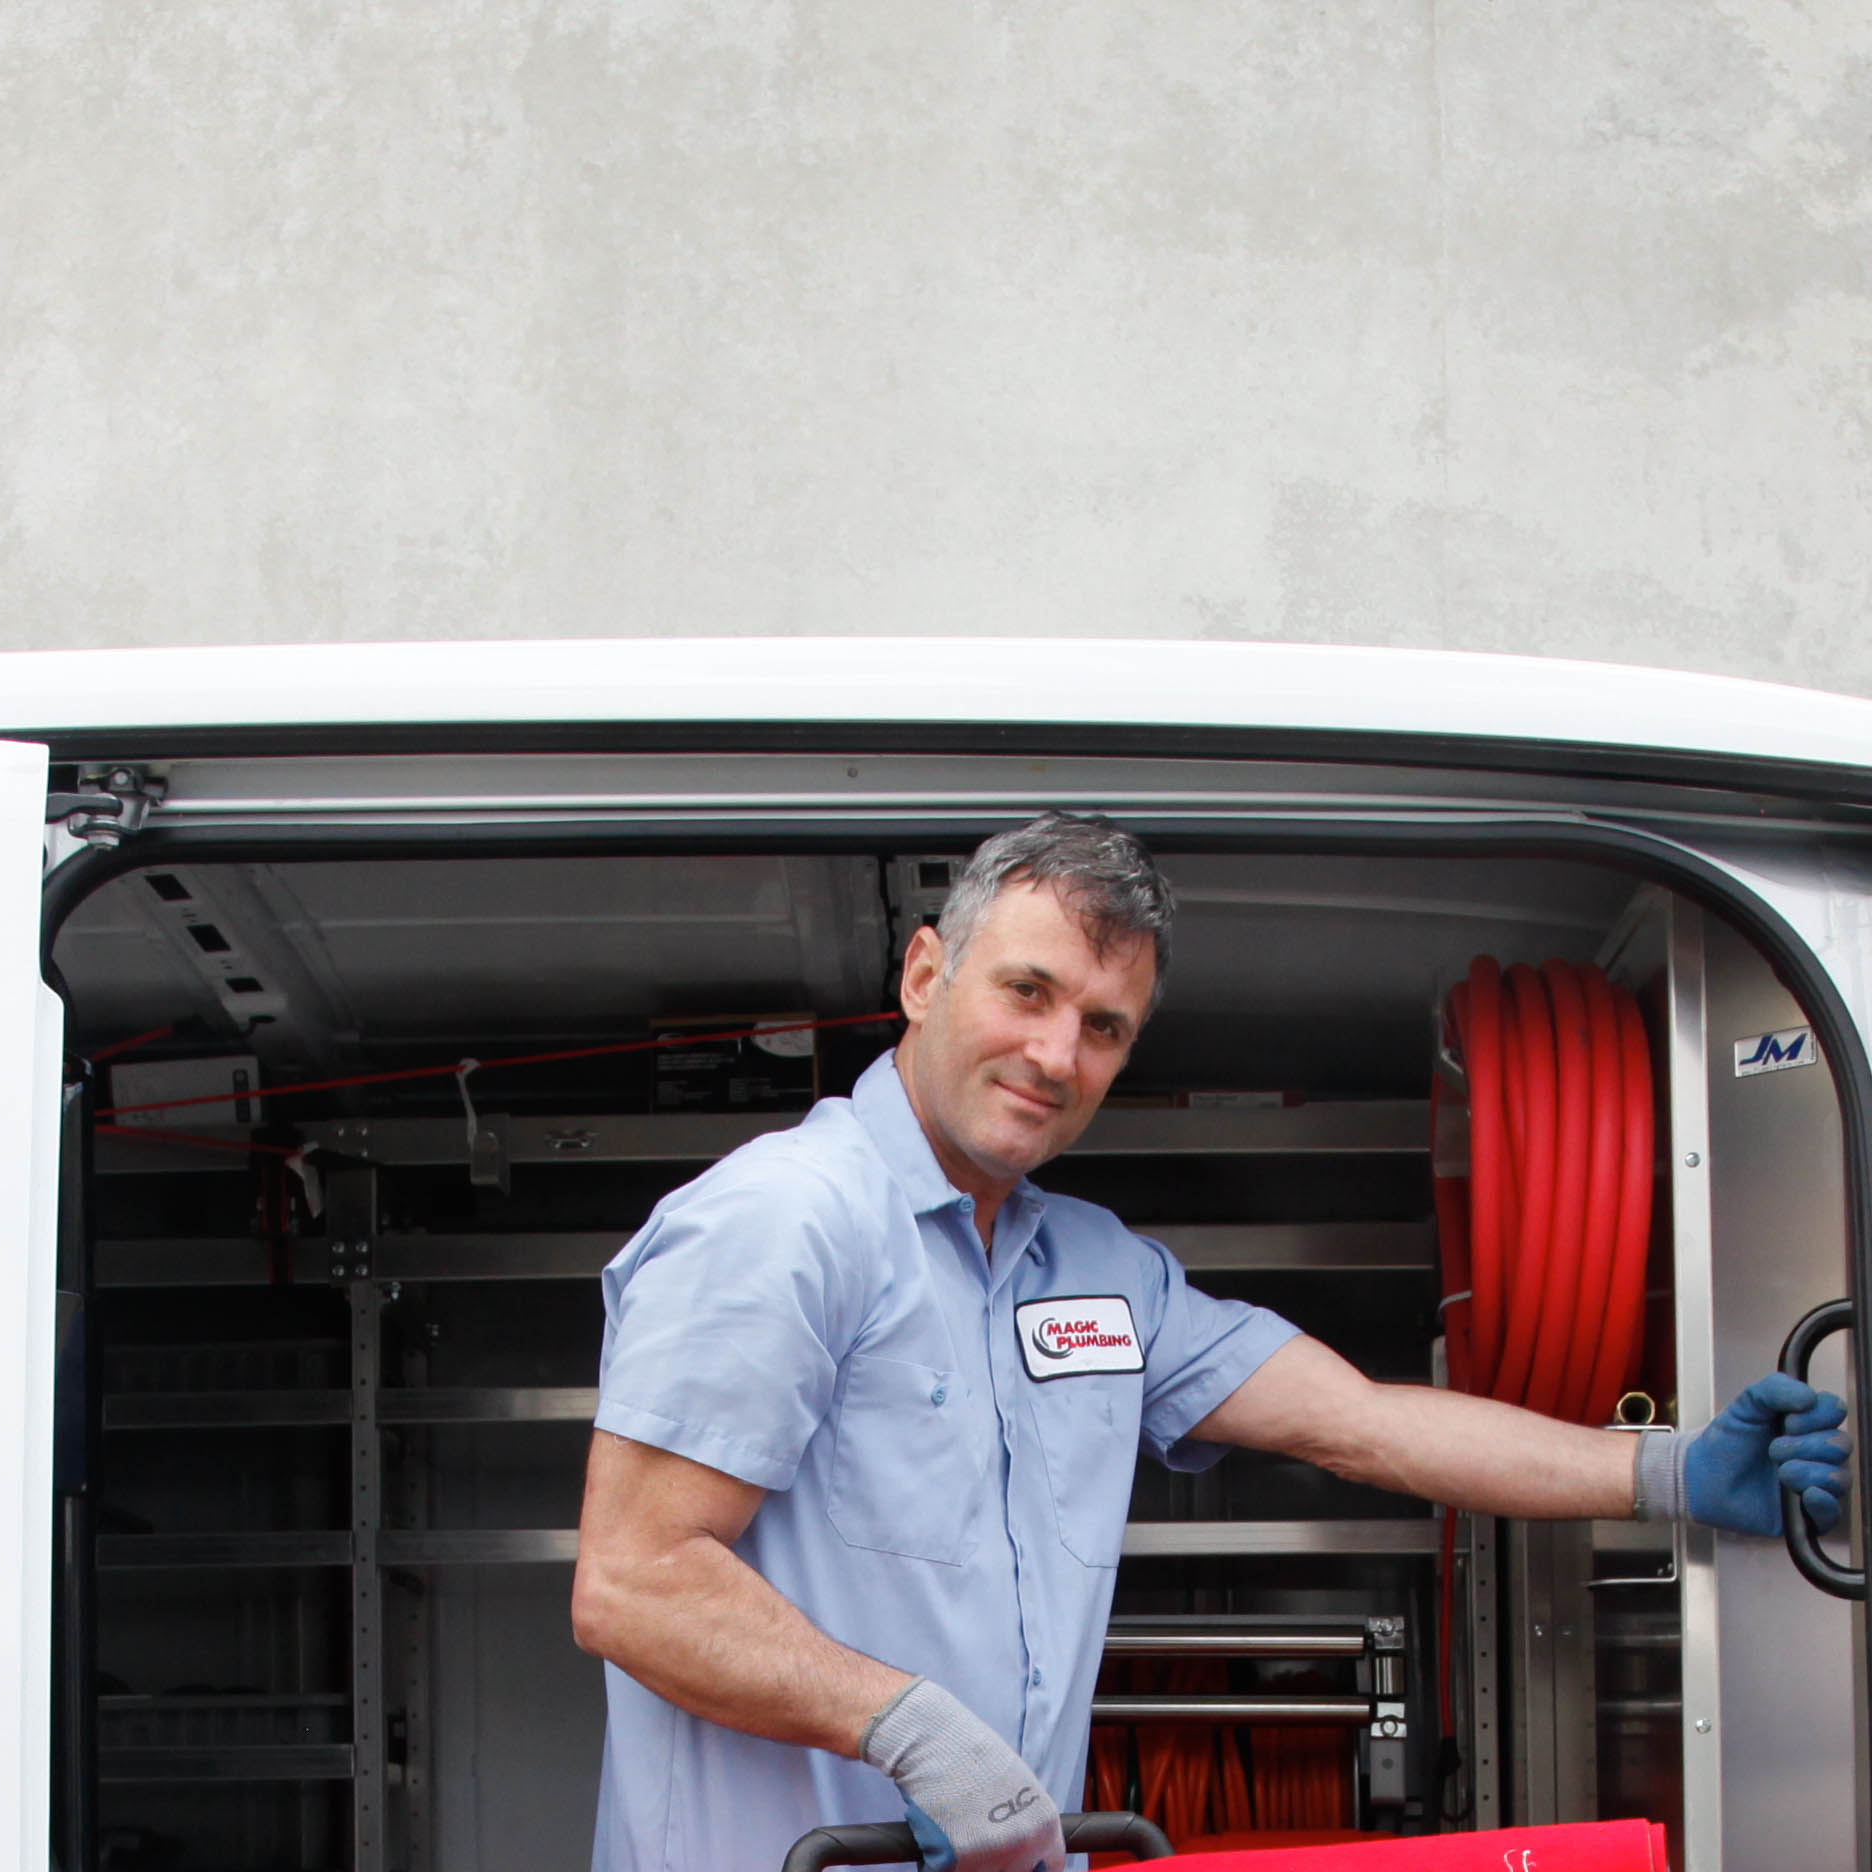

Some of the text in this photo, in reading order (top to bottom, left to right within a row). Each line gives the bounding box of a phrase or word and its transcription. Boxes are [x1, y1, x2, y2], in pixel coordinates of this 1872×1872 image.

[1740, 1033, 1808, 1066] JM
[1047, 1320, 1099, 1336] MAGIC
[1056, 1334, 1132, 1349] PLUMBING
